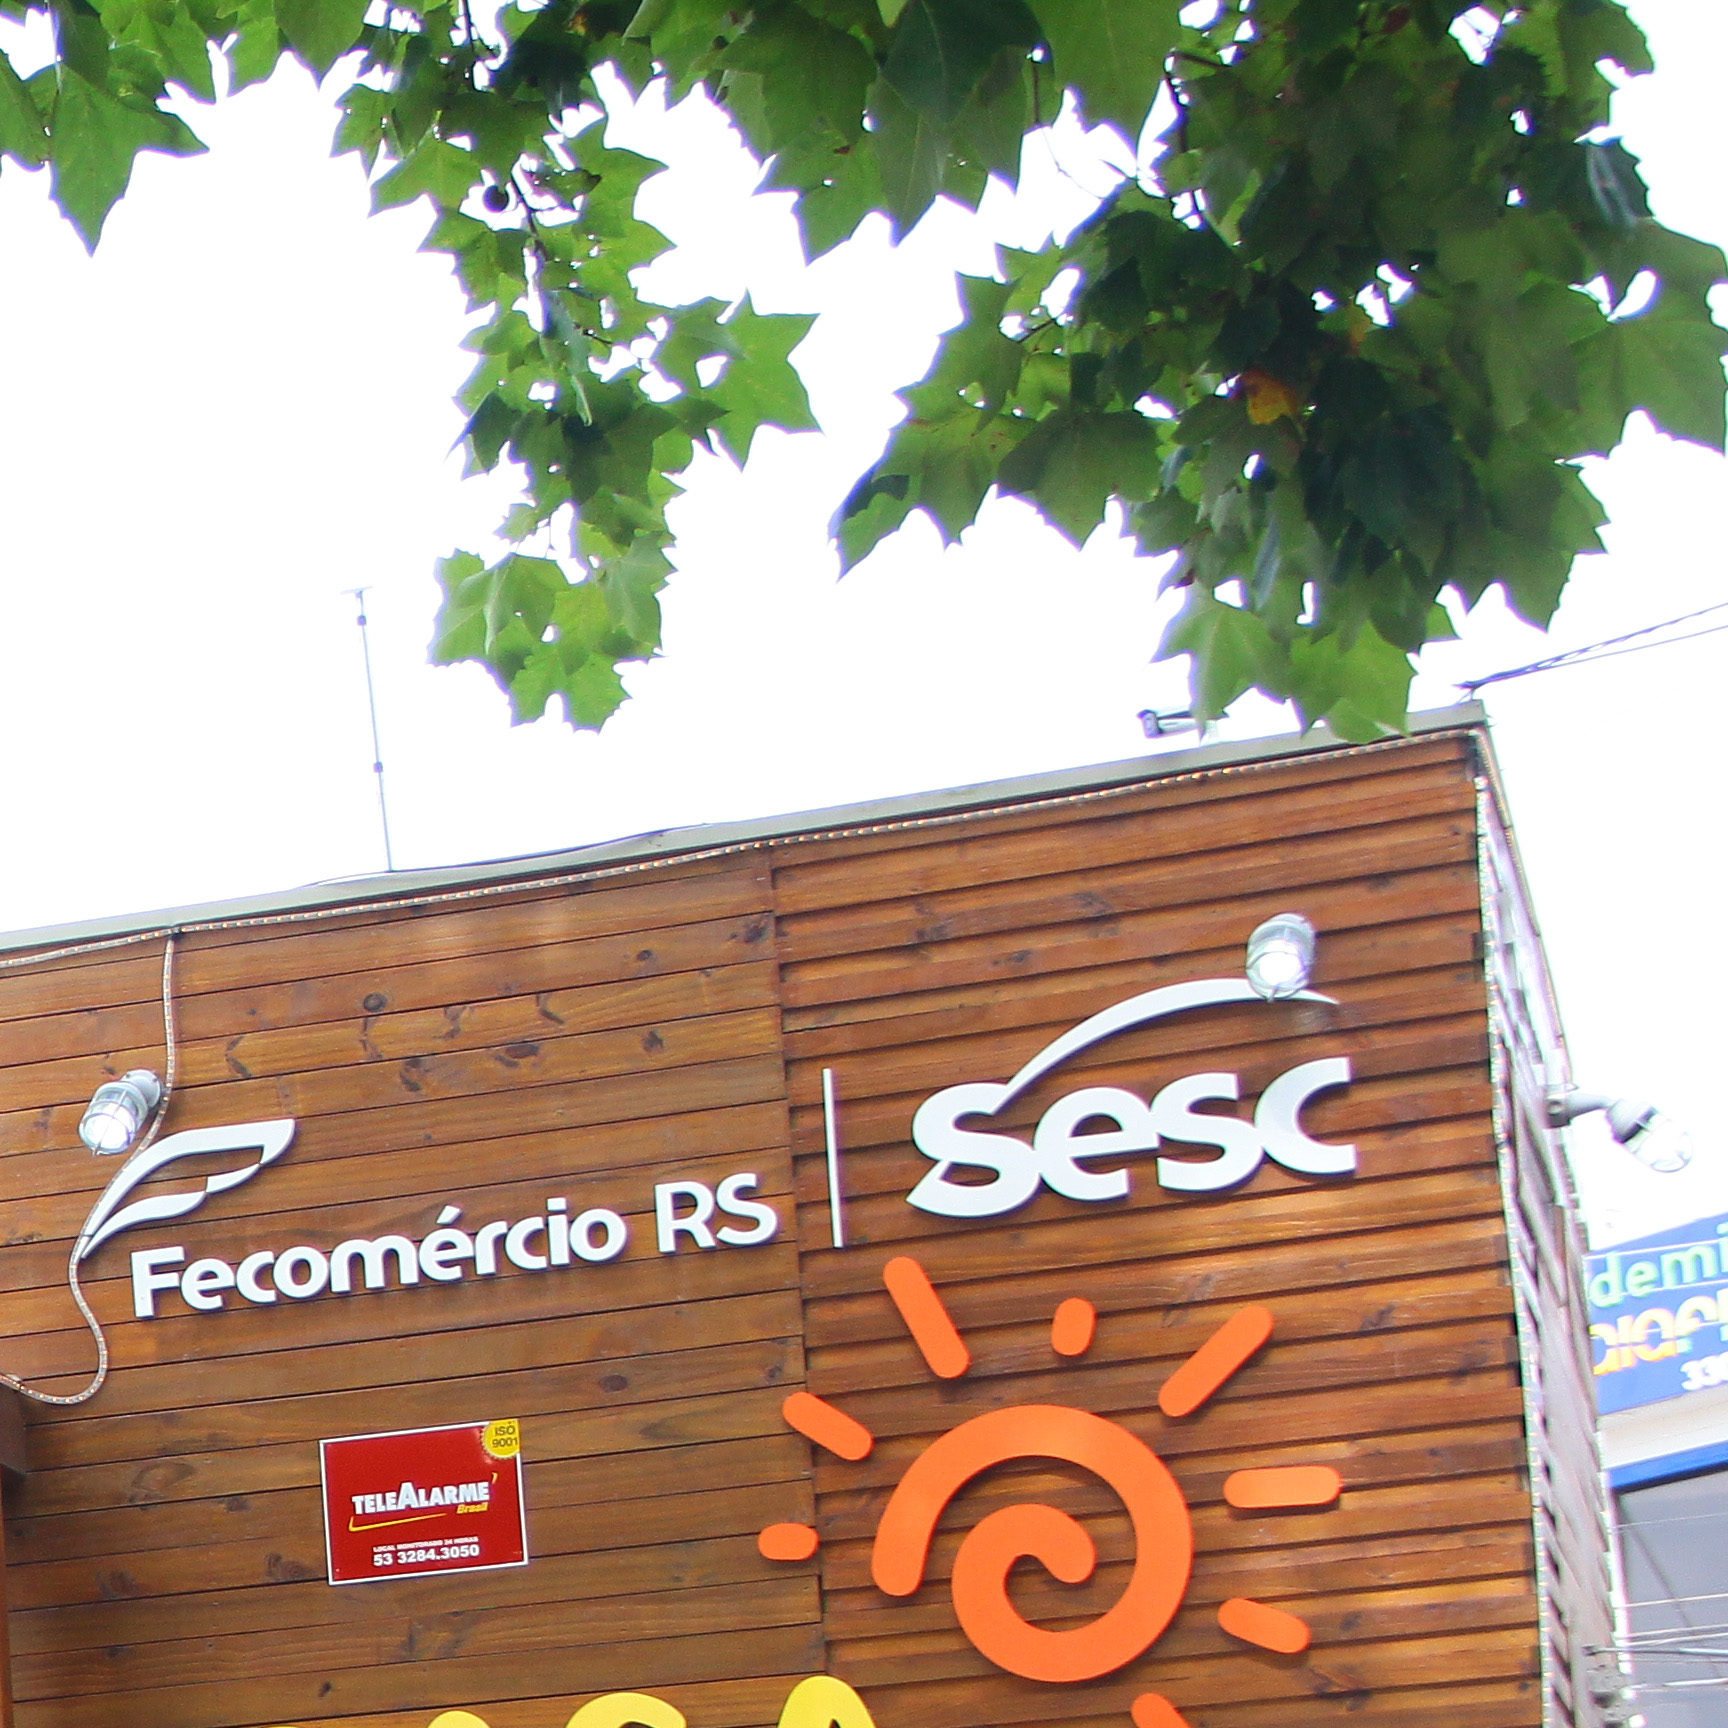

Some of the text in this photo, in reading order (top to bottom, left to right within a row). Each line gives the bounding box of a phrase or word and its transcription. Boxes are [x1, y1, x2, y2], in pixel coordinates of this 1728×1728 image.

[131, 1172, 779, 1319] Fecomércio RS
[494, 1425, 516, 1436] ISO
[492, 1438, 519, 1448] 9001
[456, 1502, 489, 1514] Brasil
[373, 1544, 480, 1566] 53 3284.3050
